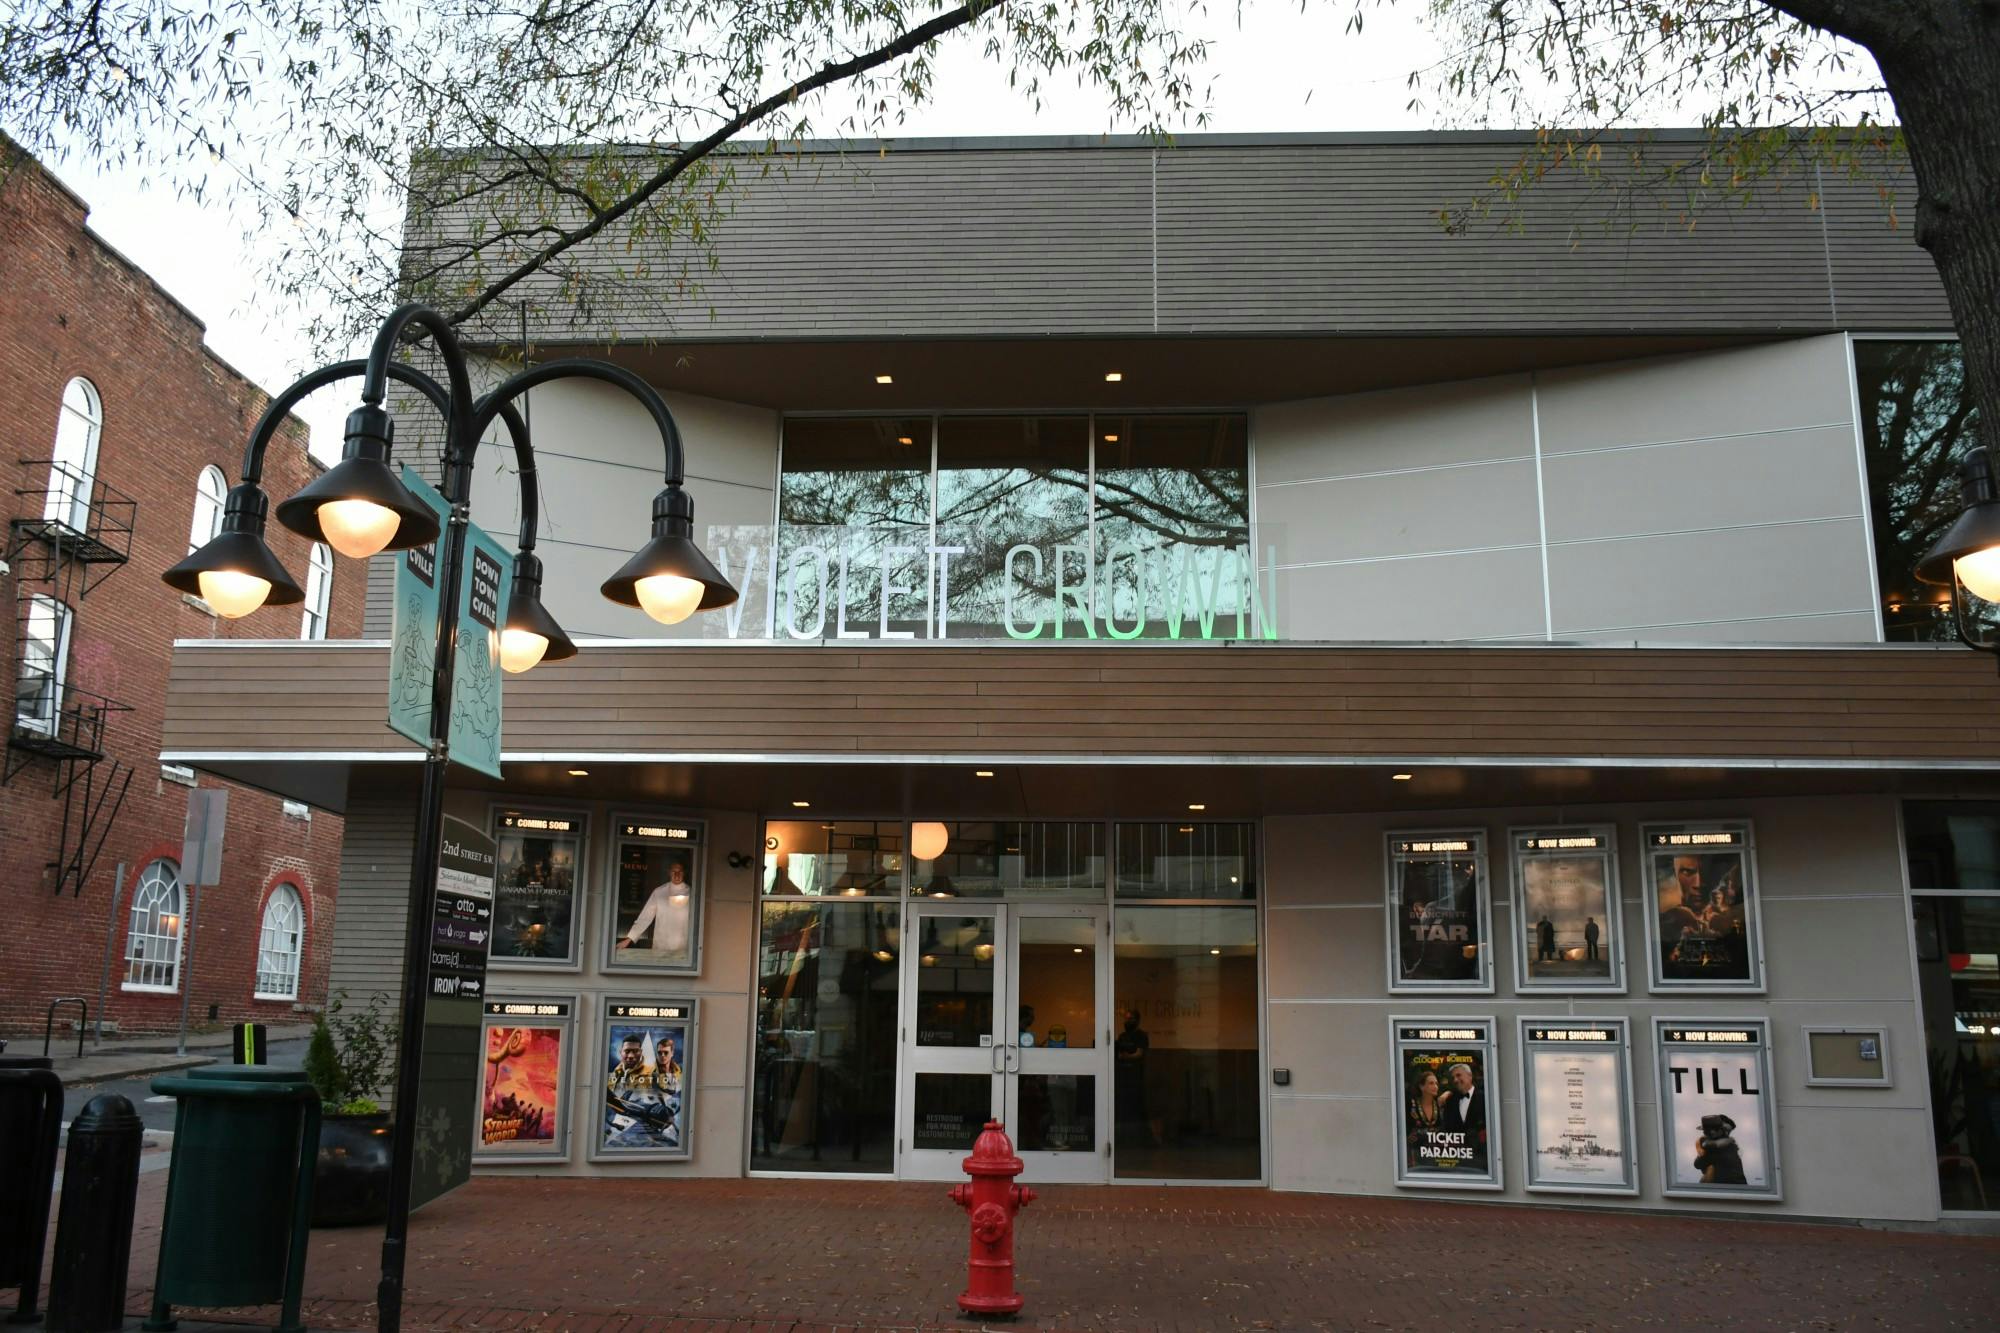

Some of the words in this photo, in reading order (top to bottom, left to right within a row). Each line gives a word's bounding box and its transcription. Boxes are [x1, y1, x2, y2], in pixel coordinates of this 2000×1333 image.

[409, 549, 433, 577] CVILLE
[475, 556, 499, 585] DOWN
[474, 576, 497, 604] TOWN
[718, 545, 965, 639] VIOLET
[1004, 544, 1277, 640] CROWN
[472, 596, 496, 623] CVILLE
[517, 819, 547, 829] COMING
[549, 821, 569, 830] SOON
[638, 827, 666, 836] COMING
[668, 829, 687, 838] SOON
[1670, 835, 1690, 844] NOW
[1692, 834, 1731, 844] SHOWING
[1412, 842, 1430, 851] NOW
[1432, 841, 1468, 851] SHOWING
[1538, 839, 1557, 848] NOW
[1558, 838, 1596, 847] SHOWING
[442, 840, 460, 856] 2nd
[461, 849, 482, 861] STREET
[457, 899, 475, 914] otto
[434, 977, 454, 994] IRON
[505, 1005, 536, 1014] COMING
[537, 1005, 559, 1014] SOON
[629, 1007, 658, 1016] COMING
[659, 1008, 679, 1017] SOON
[1420, 1030, 1438, 1039] NOW
[1439, 1030, 1476, 1039] SHOWING
[1547, 1031, 1566, 1040] NOW
[1568, 1031, 1607, 1040] SHOWING
[1685, 1031, 1705, 1041] NOW
[1707, 1031, 1748, 1041] SHOWING
[611, 1076, 678, 1084] DEVOTION
[1669, 1067, 1760, 1095] TILL
[484, 1117, 523, 1133] STRANGE
[484, 1128, 518, 1145] WORLD
[1427, 1131, 1466, 1144] TICKET
[1420, 1146, 1473, 1159] PARADISE
